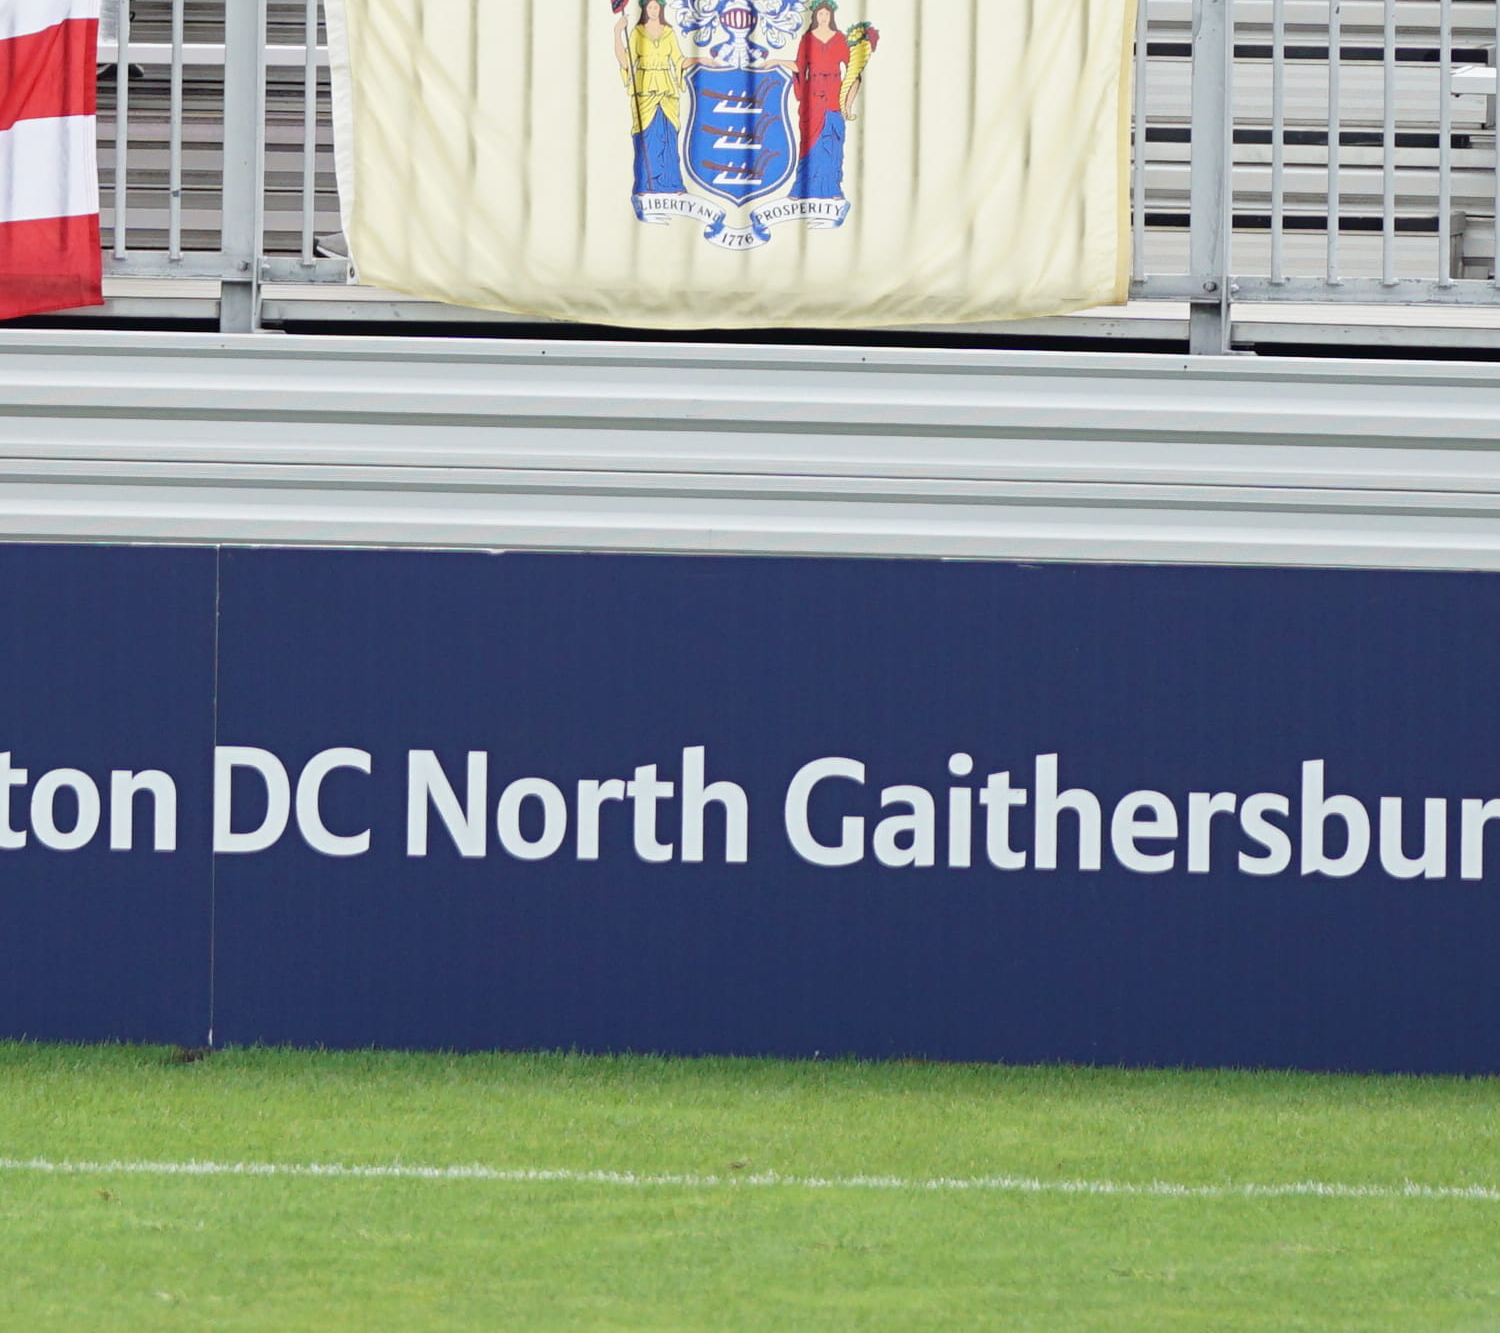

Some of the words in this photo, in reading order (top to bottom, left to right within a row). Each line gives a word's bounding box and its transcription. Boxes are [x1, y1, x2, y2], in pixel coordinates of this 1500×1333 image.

[640, 198, 696, 213] LIBERTY
[697, 206, 722, 223] AND
[756, 202, 843, 224] PROSPERITY
[721, 232, 755, 246] 1776
[211, 744, 373, 858] DC
[406, 744, 750, 866] North
